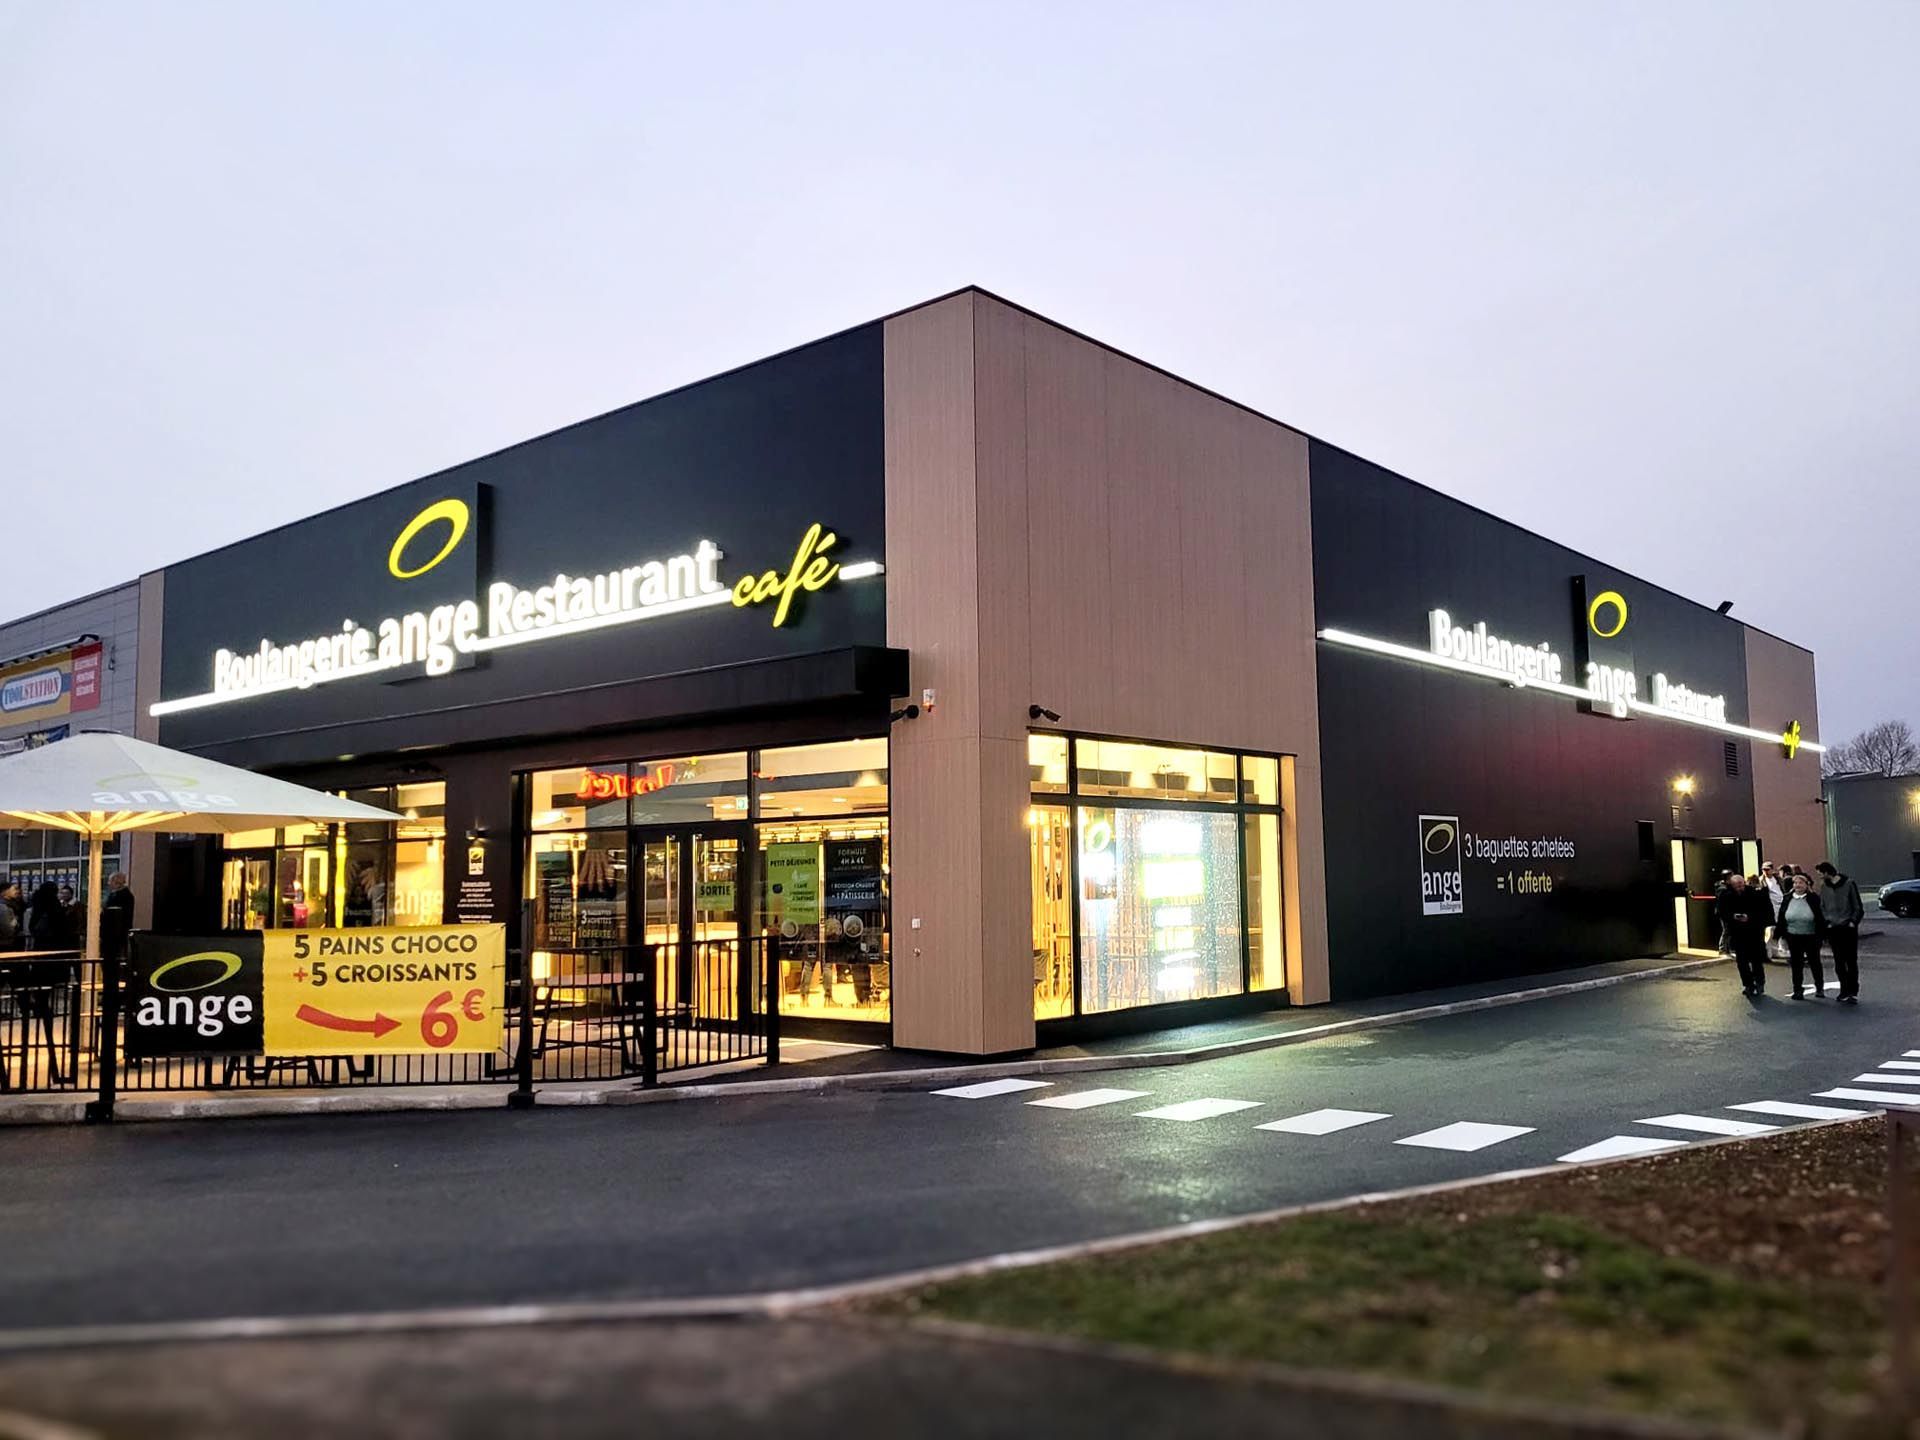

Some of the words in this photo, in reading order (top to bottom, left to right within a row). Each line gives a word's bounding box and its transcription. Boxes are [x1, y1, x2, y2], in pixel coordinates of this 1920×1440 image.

[214, 618, 376, 689] Boulangerie
[378, 599, 480, 677] ange
[488, 539, 724, 638] Restaurant
[731, 523, 839, 628] café
[1429, 608, 1563, 688] Boulangerie
[1587, 661, 1637, 719] ange
[90, 789, 240, 808] ange
[1464, 833, 1473, 858] 3
[1476, 834, 1529, 864] baguettes
[1531, 836, 1575, 858] achetées
[770, 859, 785, 867] PETIT
[786, 857, 816, 866] DÉJEUNER
[700, 885, 731, 896] SORTIE
[1423, 871, 1461, 902] ange
[1508, 870, 1514, 894] 1
[1517, 870, 1553, 894] offerte
[581, 910, 587, 924] 3
[294, 934, 310, 959] 5
[319, 935, 384, 956] PAINS
[391, 933, 478, 954] CHOCO
[335, 961, 477, 983] CROISSANTS
[136, 994, 254, 1037] ange
